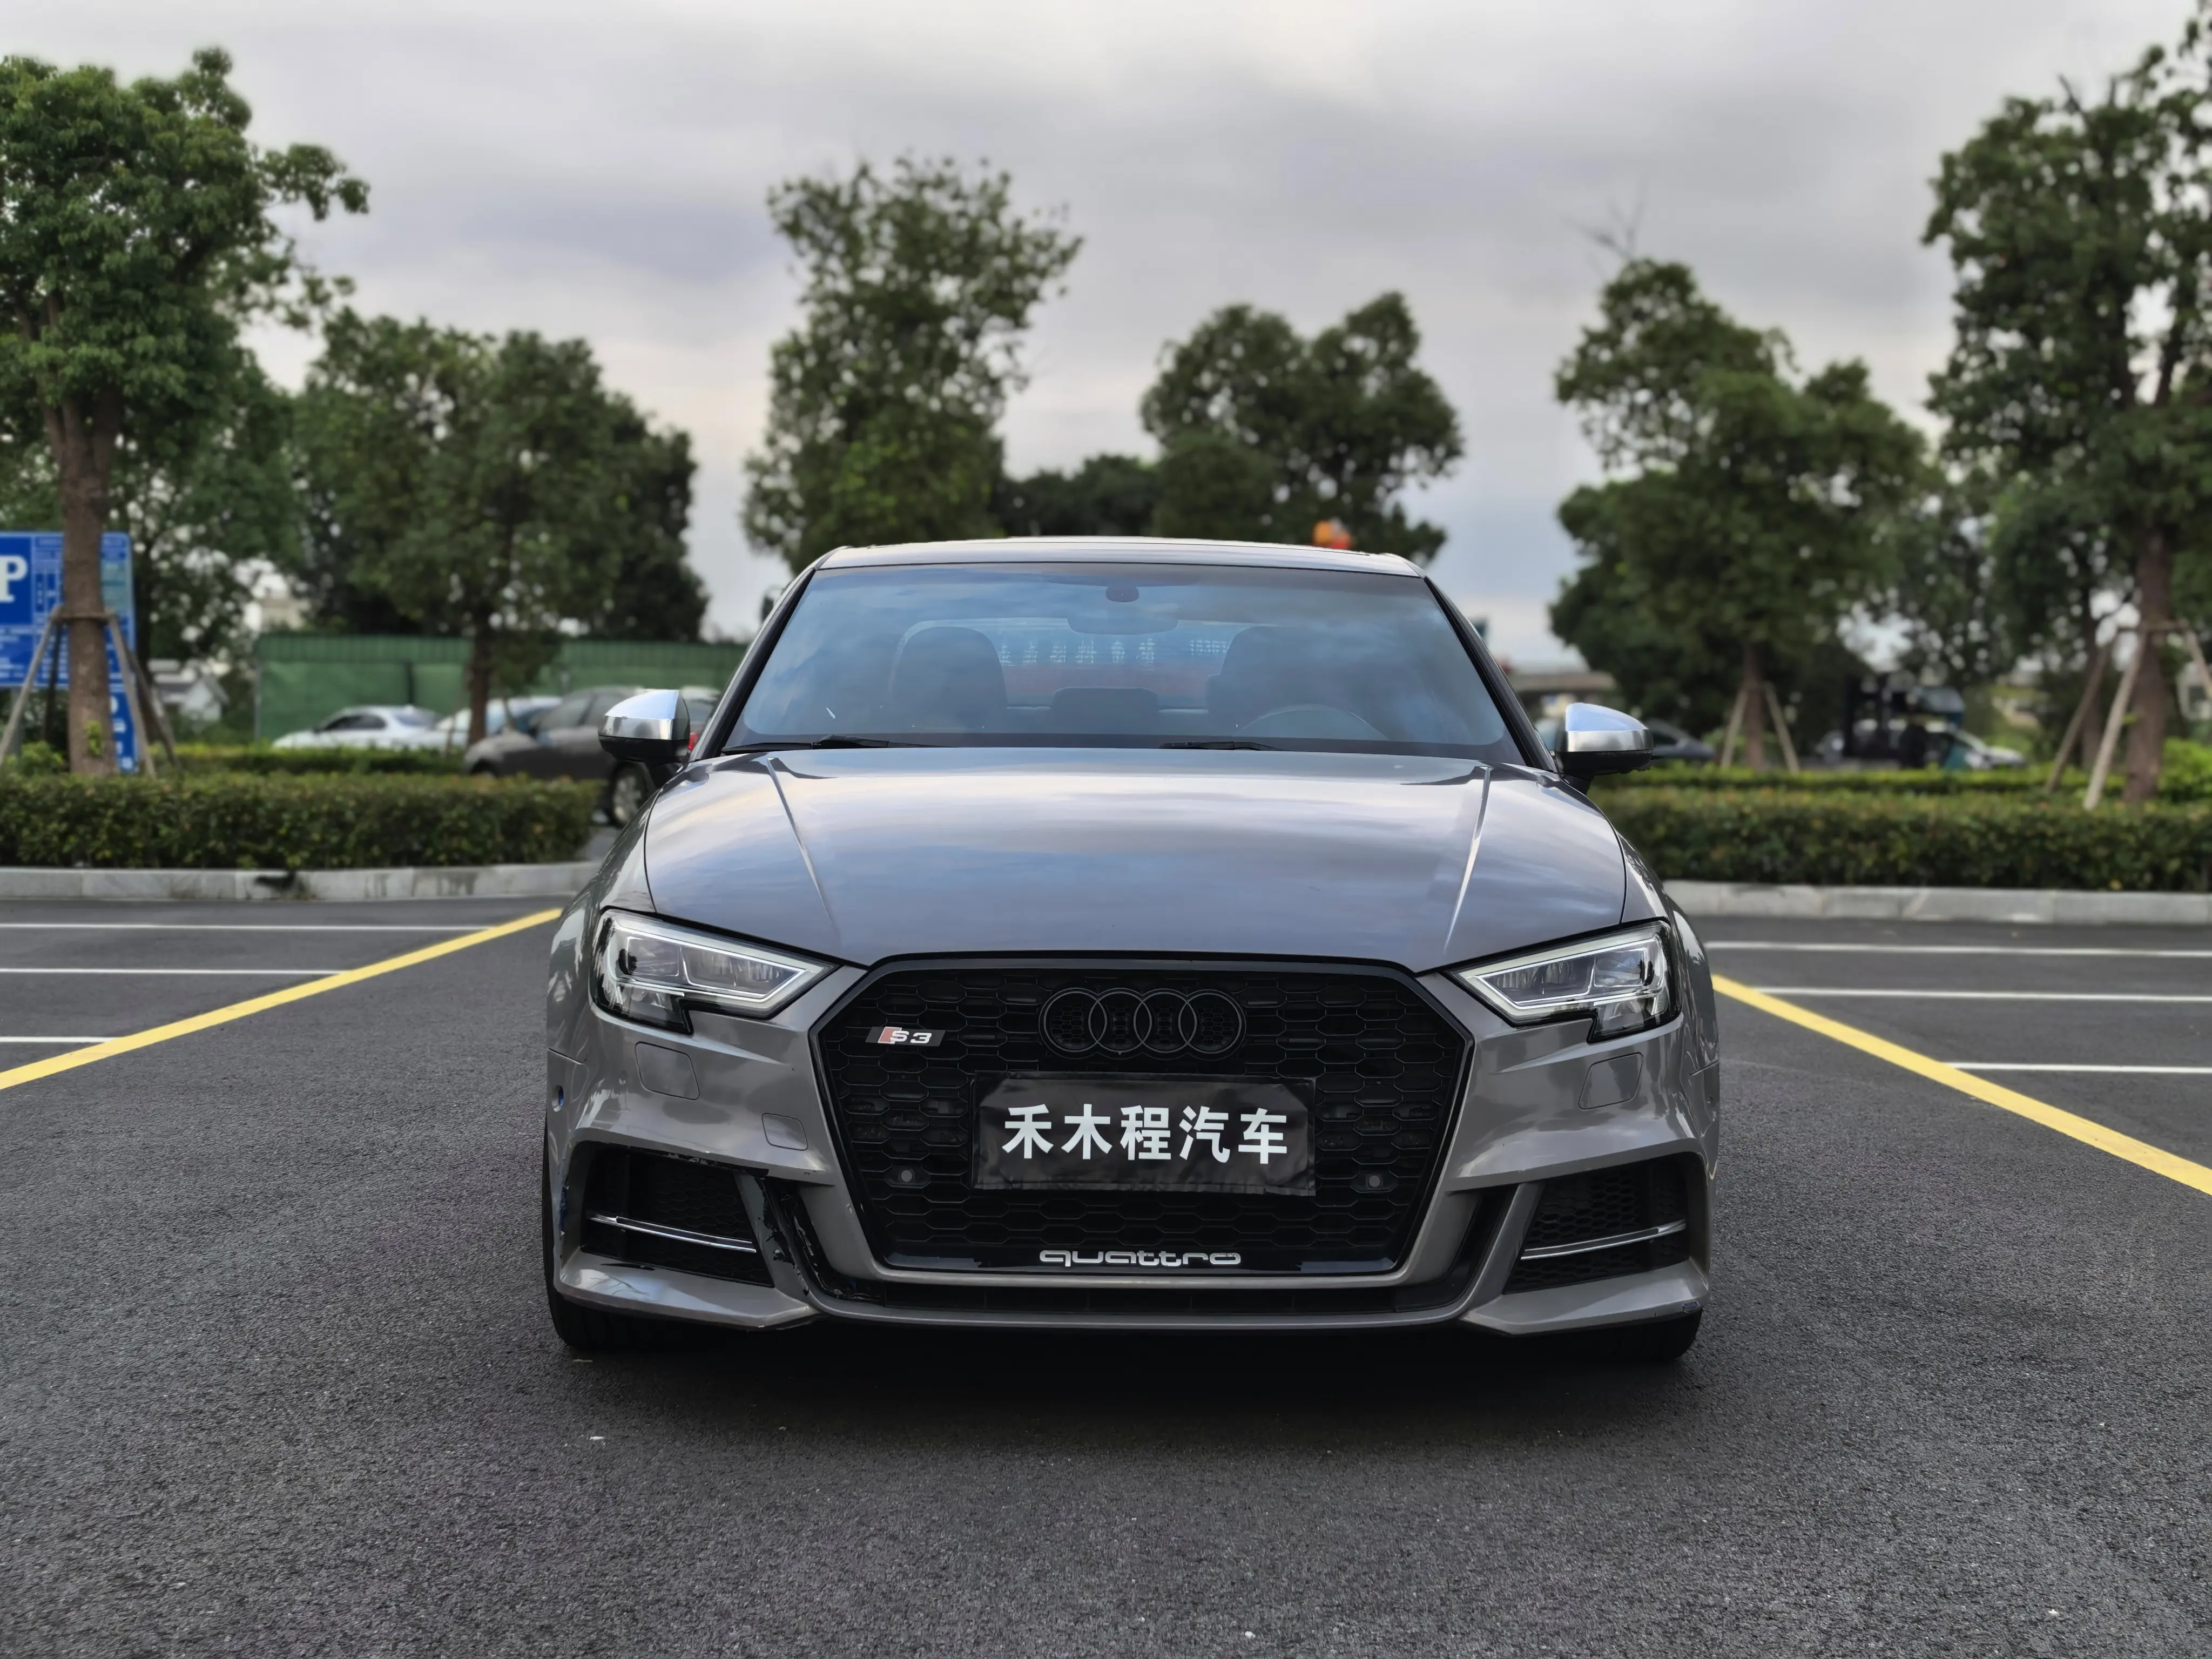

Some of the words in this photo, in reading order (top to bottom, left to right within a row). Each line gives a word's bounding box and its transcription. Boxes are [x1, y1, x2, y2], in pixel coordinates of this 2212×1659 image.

[0, 555, 28, 603] P
[890, 1030, 932, 1044] S3
[1002, 1103, 1287, 1164] 禾木程汽车
[1040, 1250, 1242, 1267] quattro
